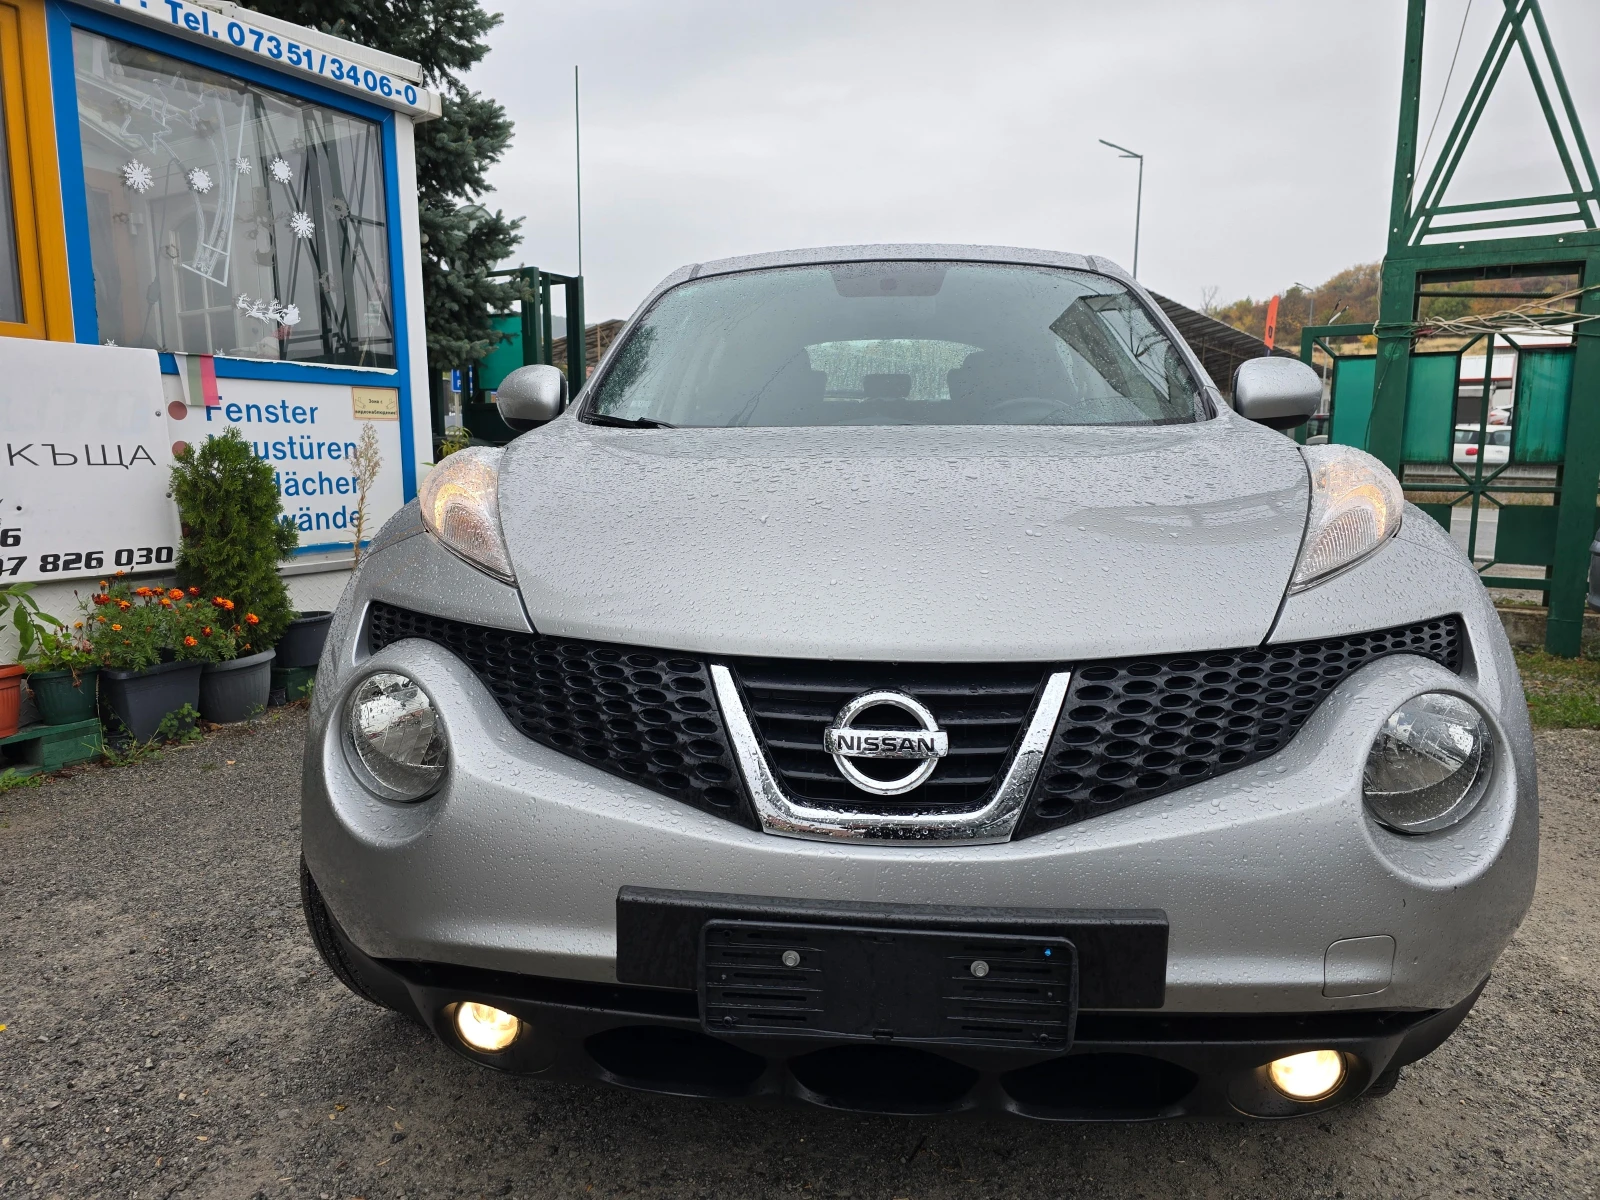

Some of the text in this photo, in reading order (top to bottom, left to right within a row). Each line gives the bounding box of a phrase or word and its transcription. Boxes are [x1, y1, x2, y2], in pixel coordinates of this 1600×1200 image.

[164, 0, 417, 106] Tel. 07351/3406-0
[6, 442, 157, 470] КЪЩА
[0, 546, 174, 577] 7 826 030
[837, 734, 936, 753] NISSAN
